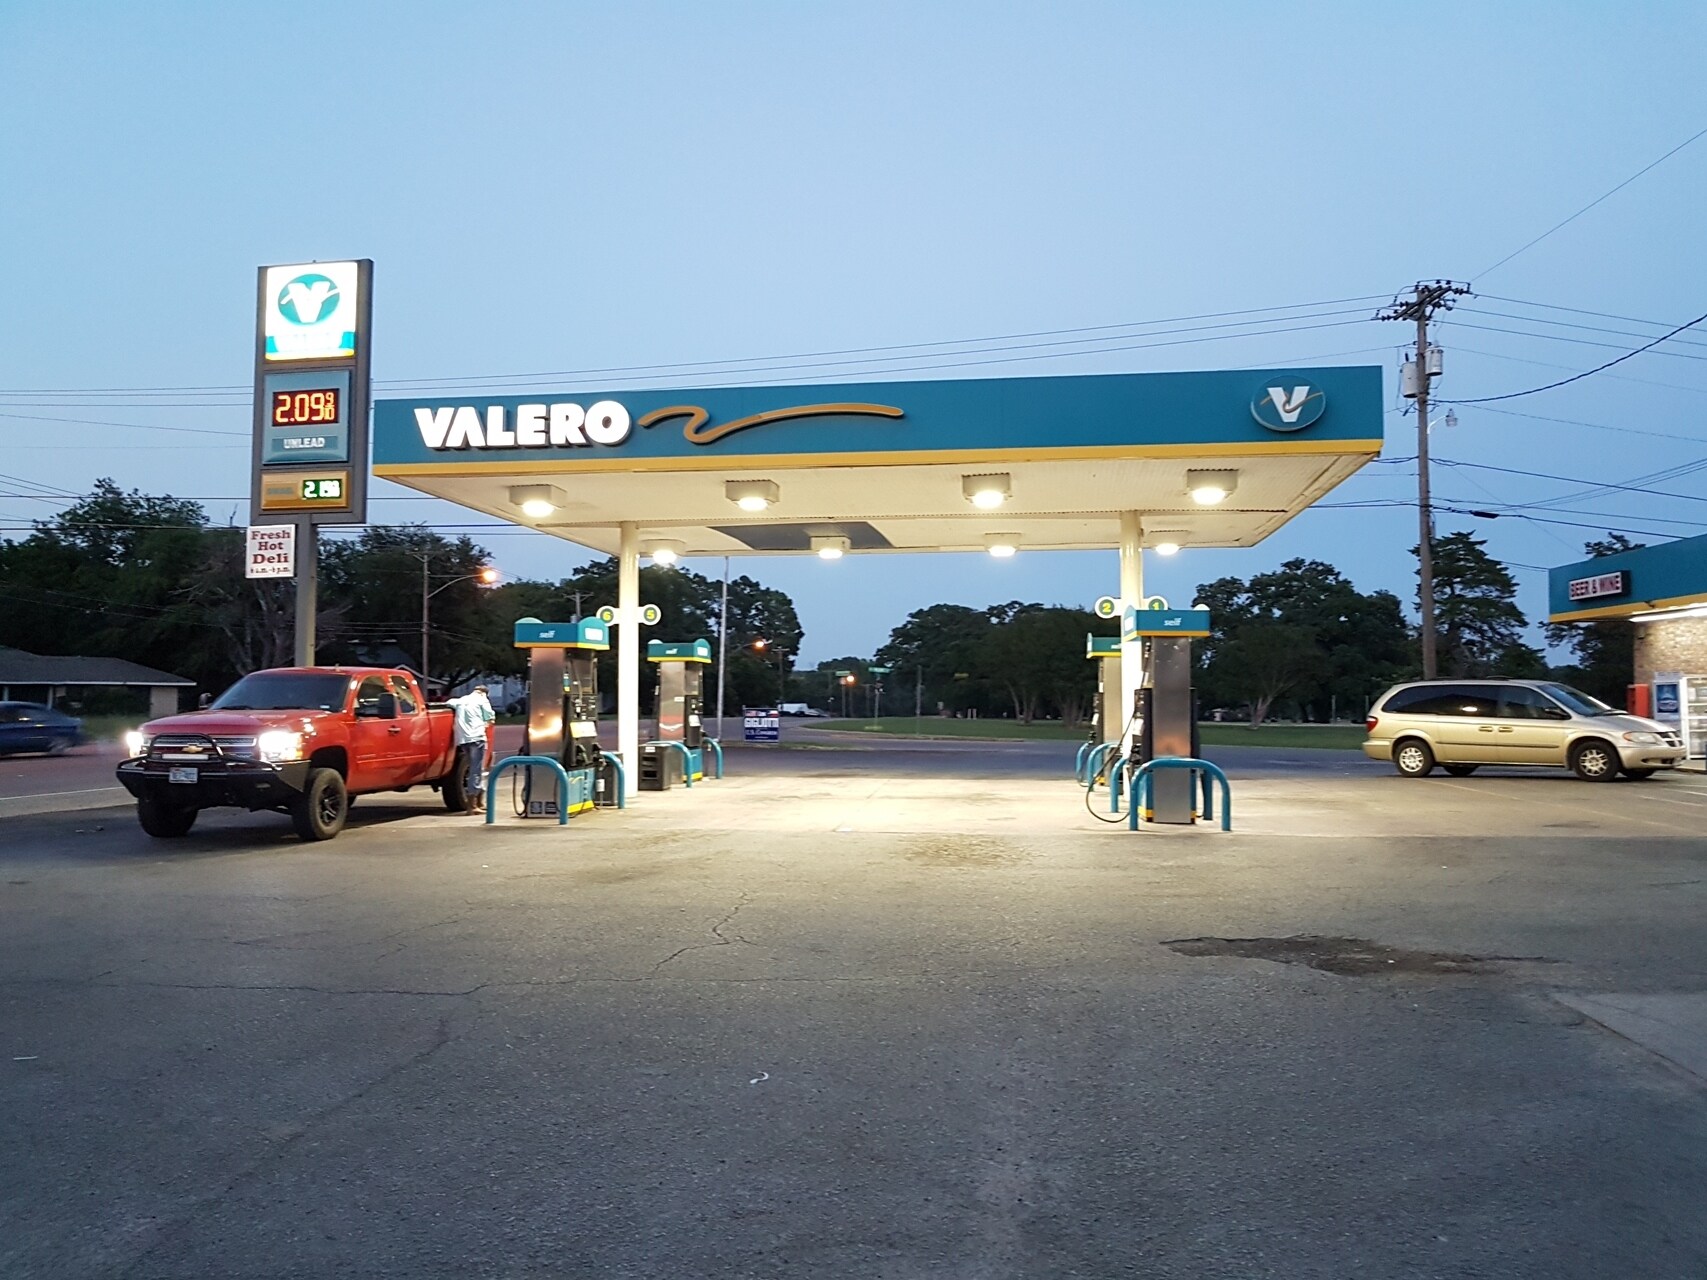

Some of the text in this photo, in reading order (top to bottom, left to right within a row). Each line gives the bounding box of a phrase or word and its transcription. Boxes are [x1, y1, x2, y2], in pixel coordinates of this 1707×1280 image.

[1266, 385, 1310, 423] V
[413, 400, 632, 449] VALERO
[283, 437, 326, 450] UNLEAD
[251, 530, 291, 540] Fresh
[258, 541, 284, 551] Hot
[252, 553, 289, 564] Deli
[1571, 581, 1589, 598] BEER
[1599, 574, 1620, 592] WINE
[1102, 602, 1112, 613] 2
[646, 609, 655, 620] 5
